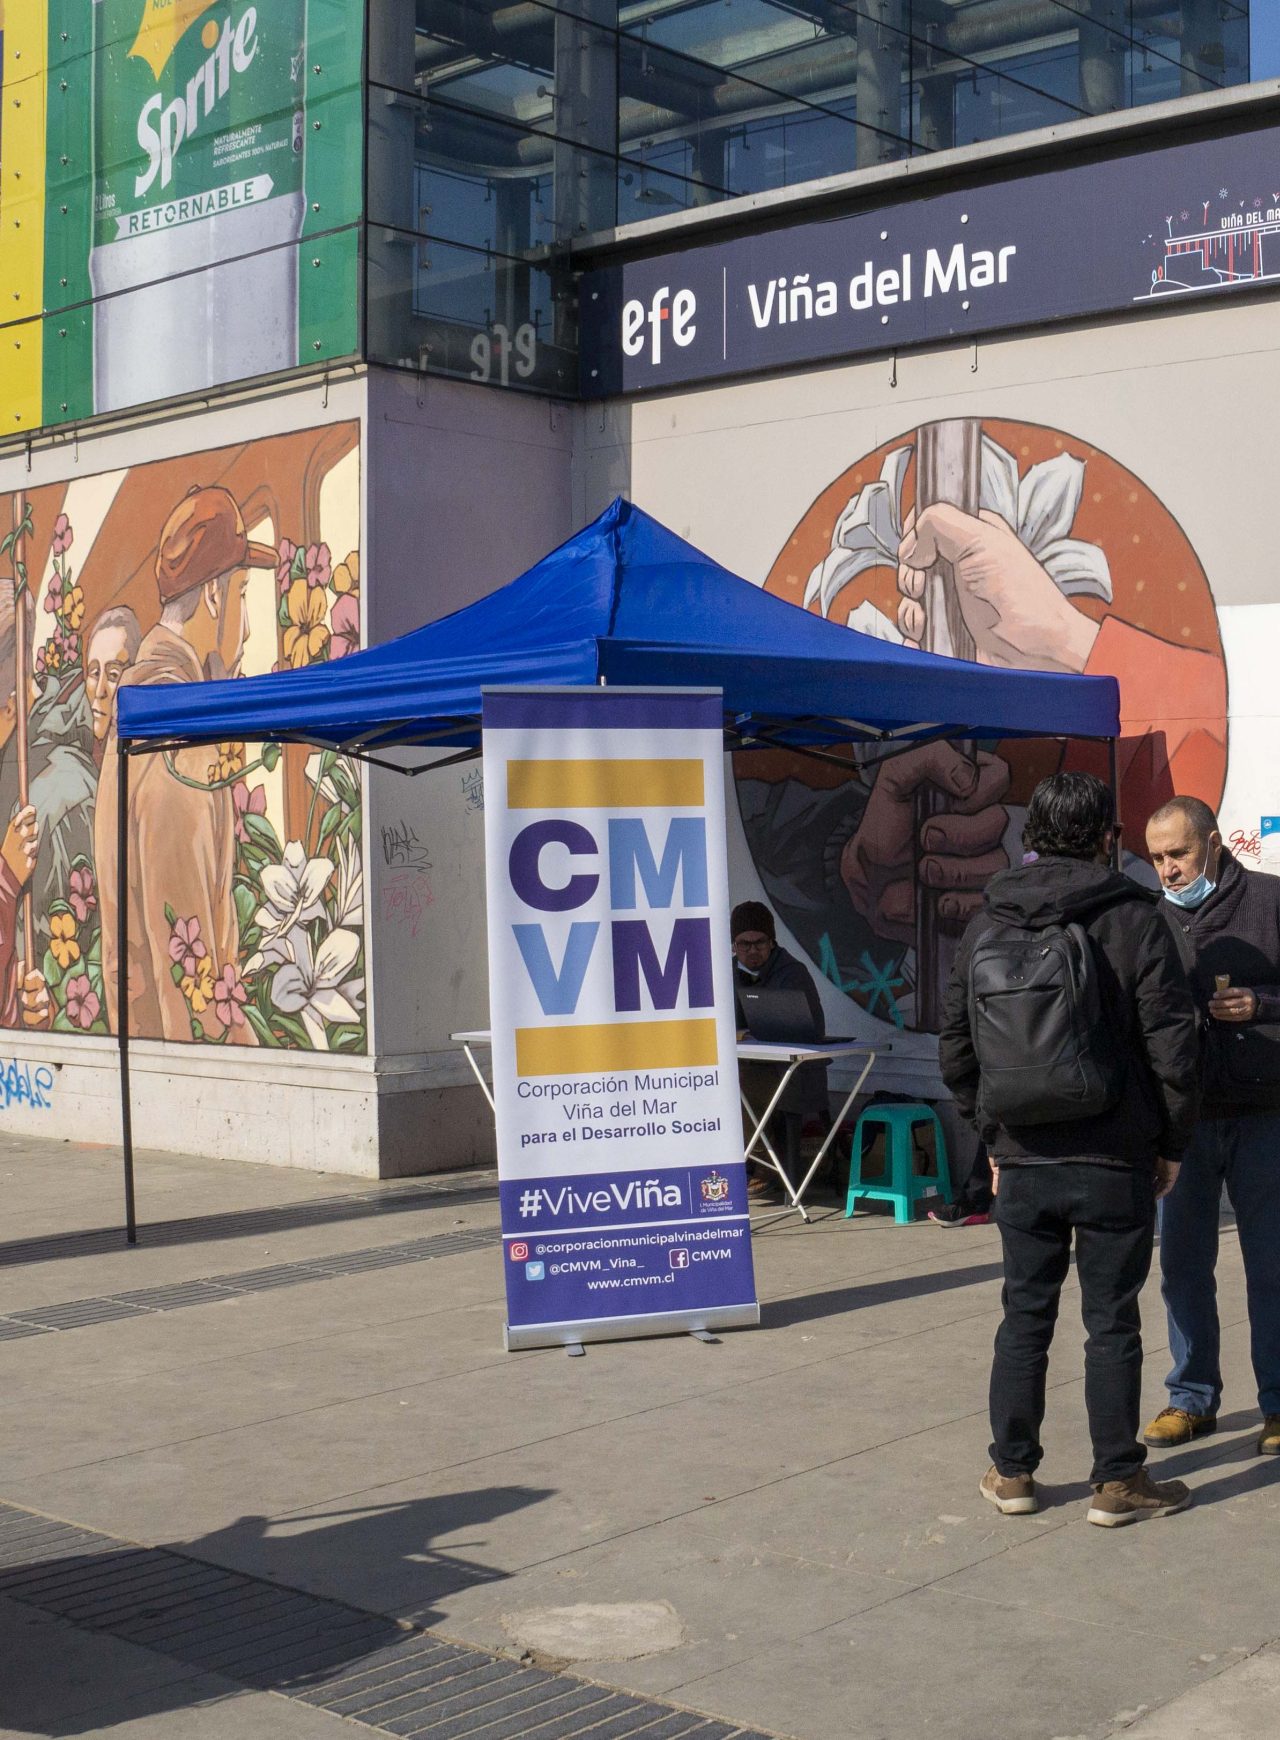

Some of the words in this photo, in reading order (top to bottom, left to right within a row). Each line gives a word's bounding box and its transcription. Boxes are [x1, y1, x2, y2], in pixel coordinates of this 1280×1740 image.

[134, 6, 258, 198] Sprite
[213, 136, 256, 156] REFRESCANTE
[214, 124, 262, 146] NATURALMENTE
[129, 181, 255, 234] RETORNABLE
[1246, 211, 1264, 225] DEL
[747, 274, 837, 329] Viña
[849, 254, 911, 310] del
[923, 243, 1016, 297] Mar
[622, 286, 697, 364] efe
[517, 1077, 629, 1100] Corporación
[634, 1070, 719, 1091] Municipal
[563, 1103, 604, 1120] Viña
[610, 1101, 636, 1117] del
[643, 1099, 678, 1115] Mar
[521, 1130, 557, 1147] para
[562, 1127, 576, 1141] el
[582, 1122, 667, 1141] Desarrollo
[672, 1118, 721, 1134] Social
[519, 1179, 682, 1218] #ViveViña
[535, 1227, 744, 1256] @corporacionmunicipalvinadelmar
[691, 1248, 732, 1262] CMVM
[549, 1257, 645, 1275] @CMVM_Vina_
[587, 1272, 675, 1290] www.cmvm.cl
